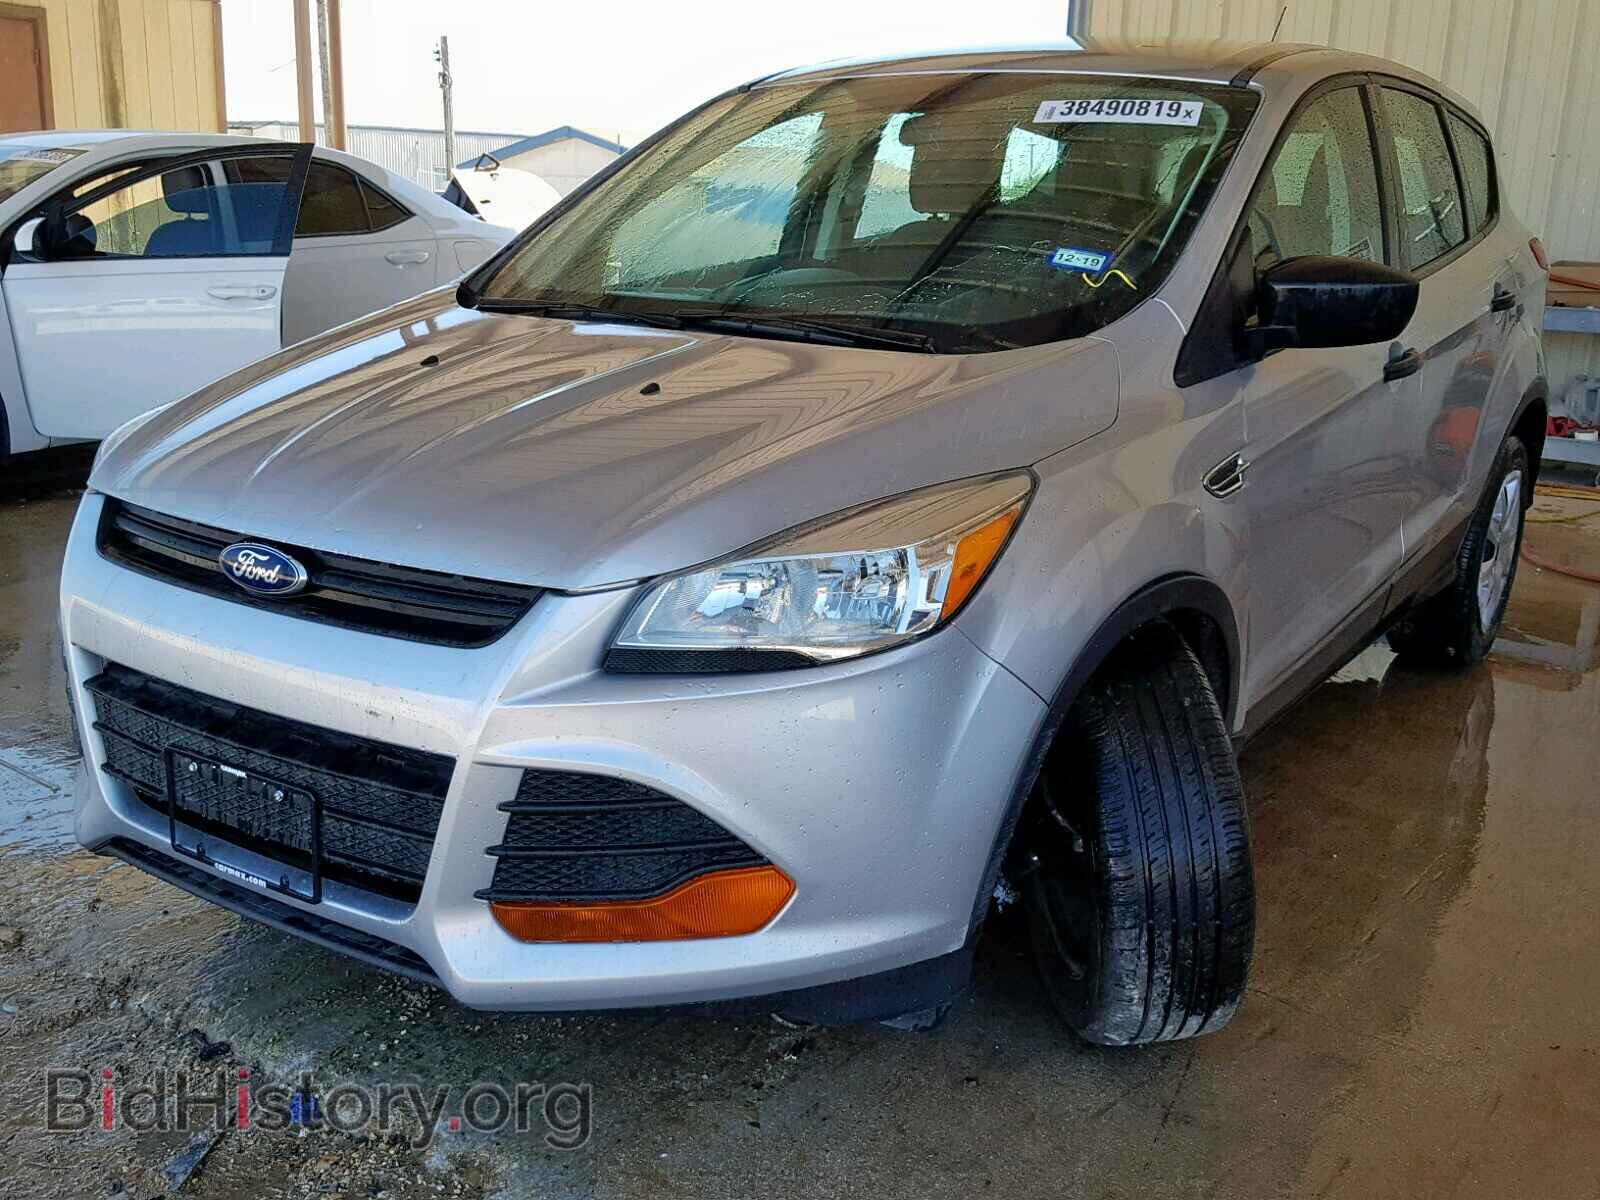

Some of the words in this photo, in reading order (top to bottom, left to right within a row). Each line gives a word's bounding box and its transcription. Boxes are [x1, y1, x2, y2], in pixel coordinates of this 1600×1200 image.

[1060, 101, 1182, 118] 38490819
[232, 549, 281, 583] Ford
[214, 862, 266, 889] carmax.com
